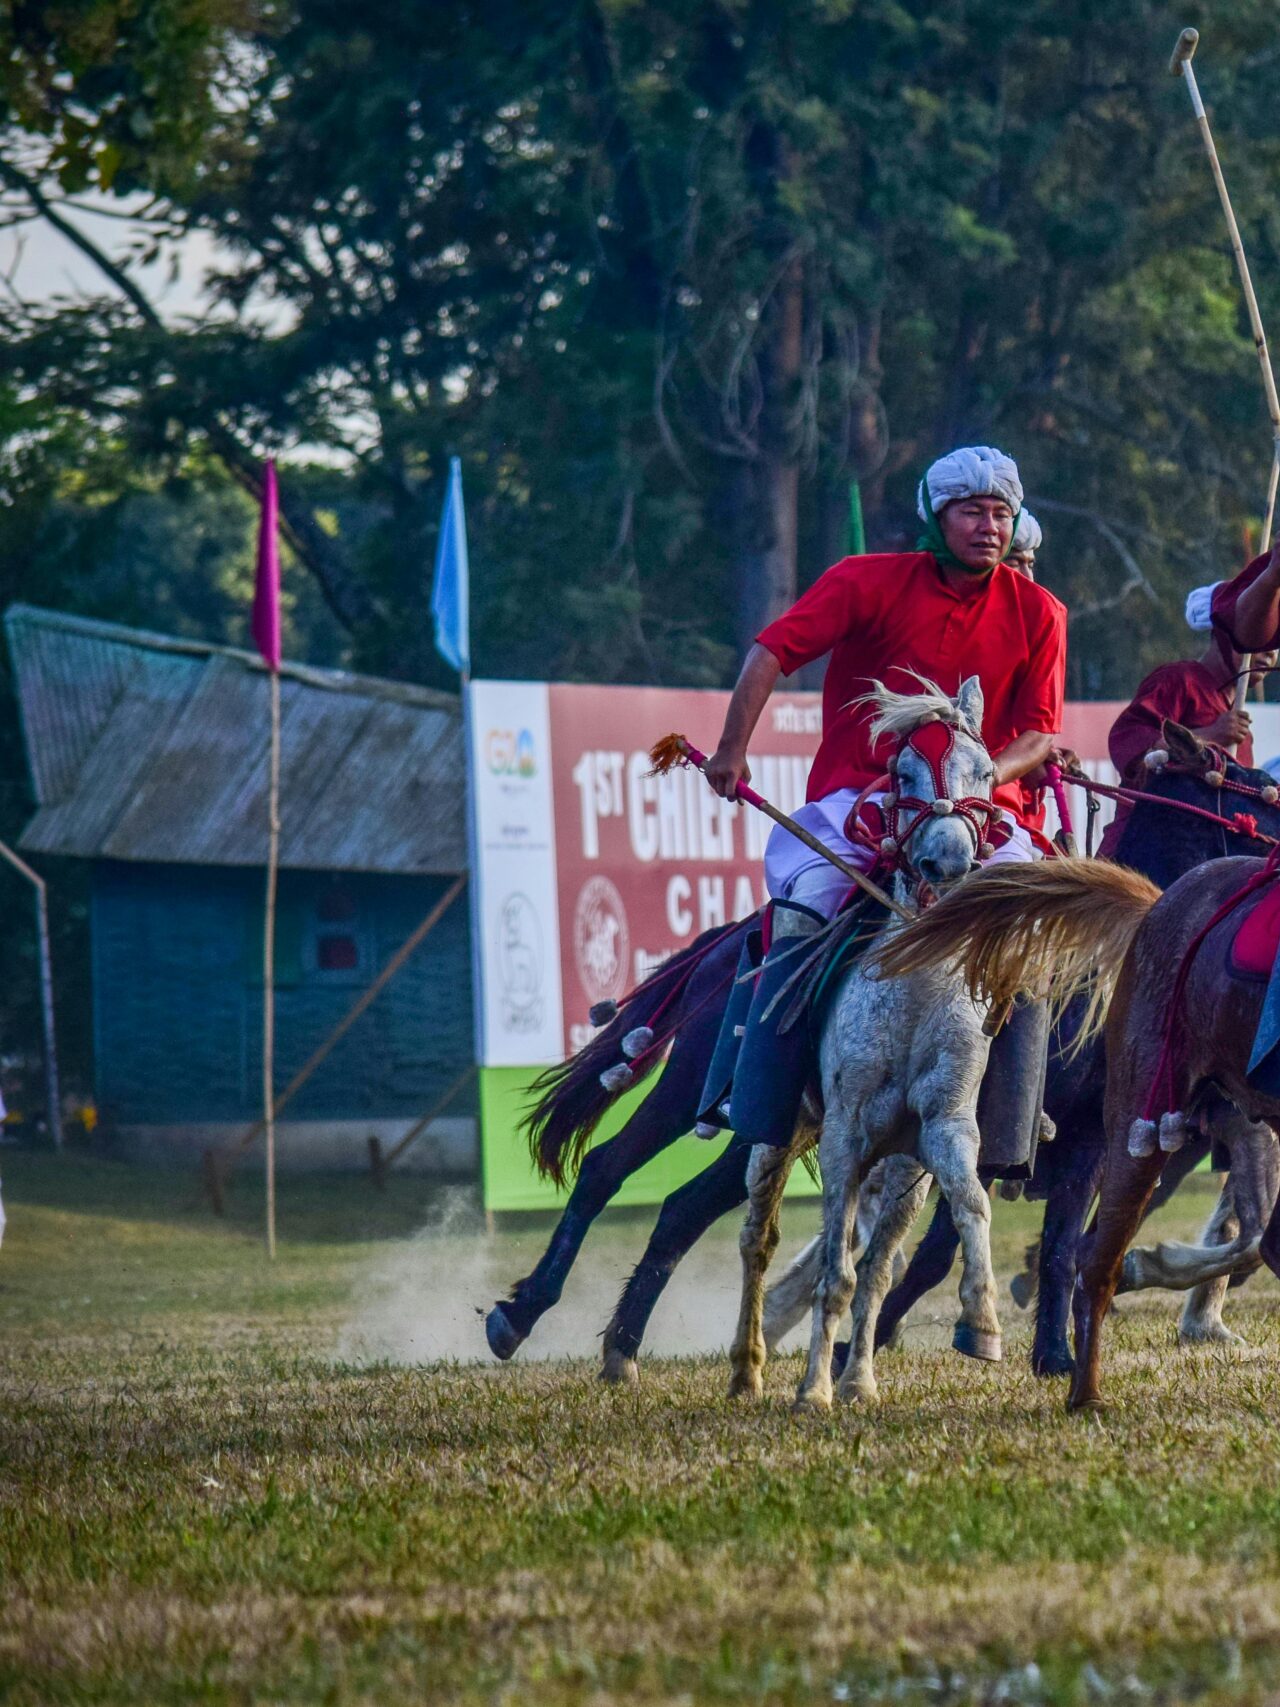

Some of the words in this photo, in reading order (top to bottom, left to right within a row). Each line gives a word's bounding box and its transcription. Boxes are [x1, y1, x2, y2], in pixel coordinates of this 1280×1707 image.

[573, 749, 625, 860] 1ST
[627, 749, 739, 863] CHIEF
[665, 875, 768, 937] CHA
